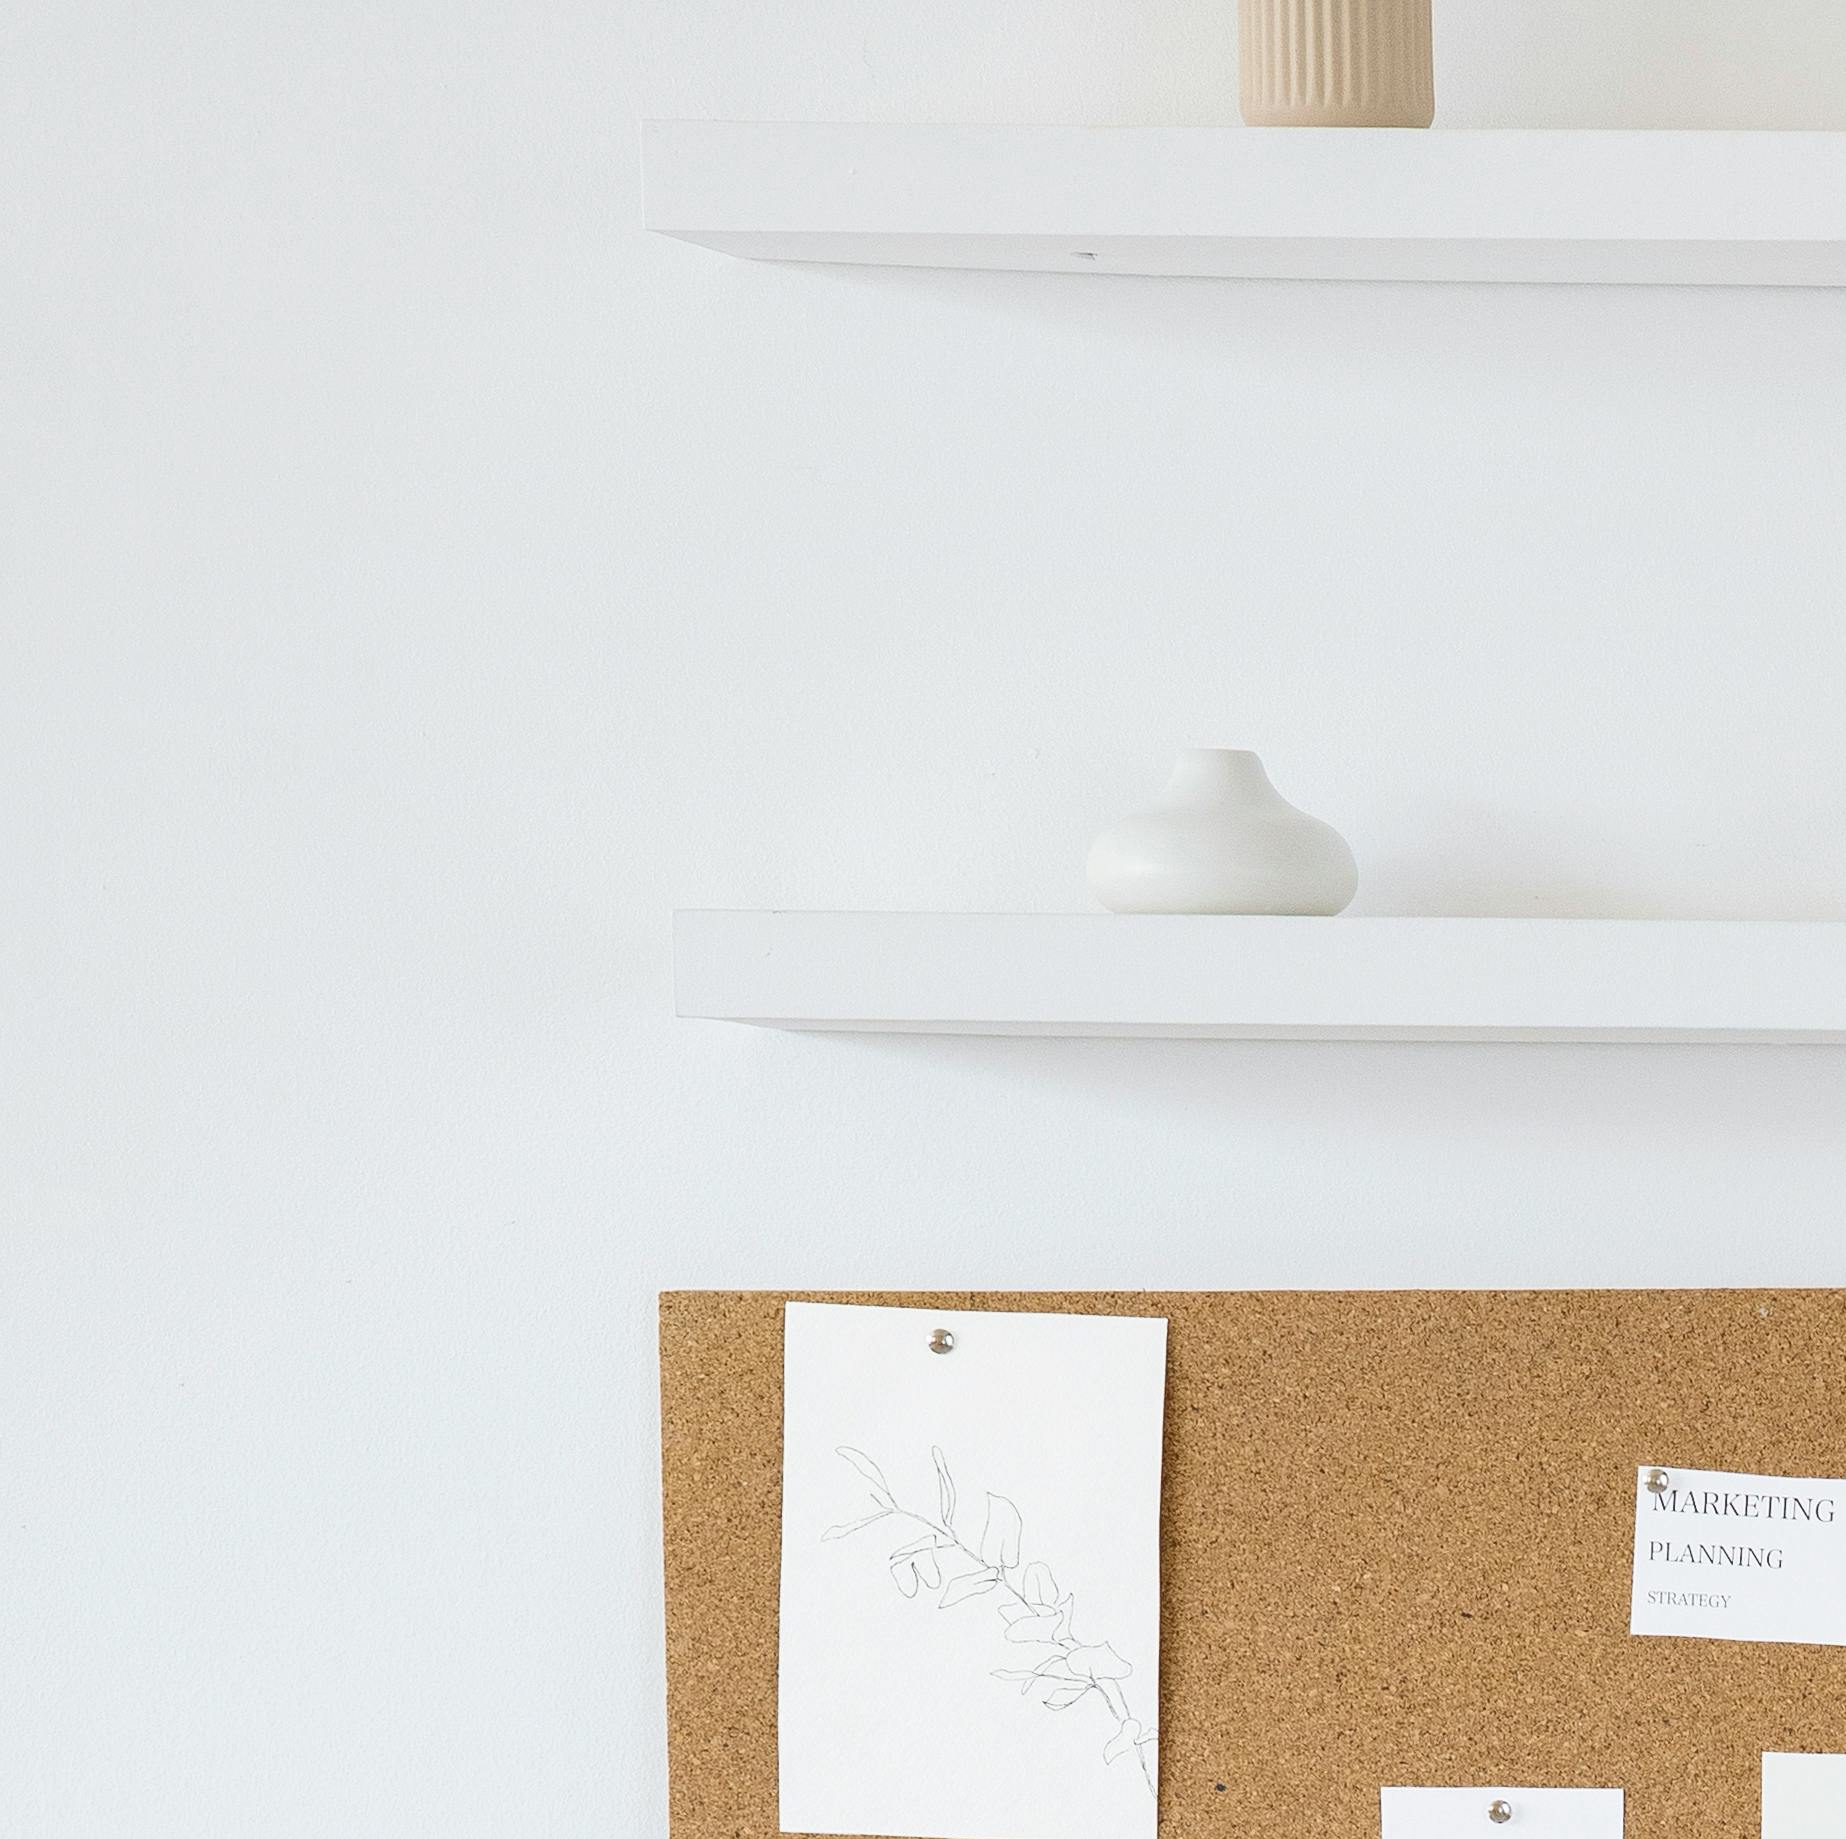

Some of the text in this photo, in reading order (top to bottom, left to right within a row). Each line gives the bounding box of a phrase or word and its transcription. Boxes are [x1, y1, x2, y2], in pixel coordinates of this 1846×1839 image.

[1652, 1489, 1836, 1523] MARKETING
[1648, 1540, 1784, 1570] PLANNING
[1647, 1590, 1732, 1609] STRATEGY
